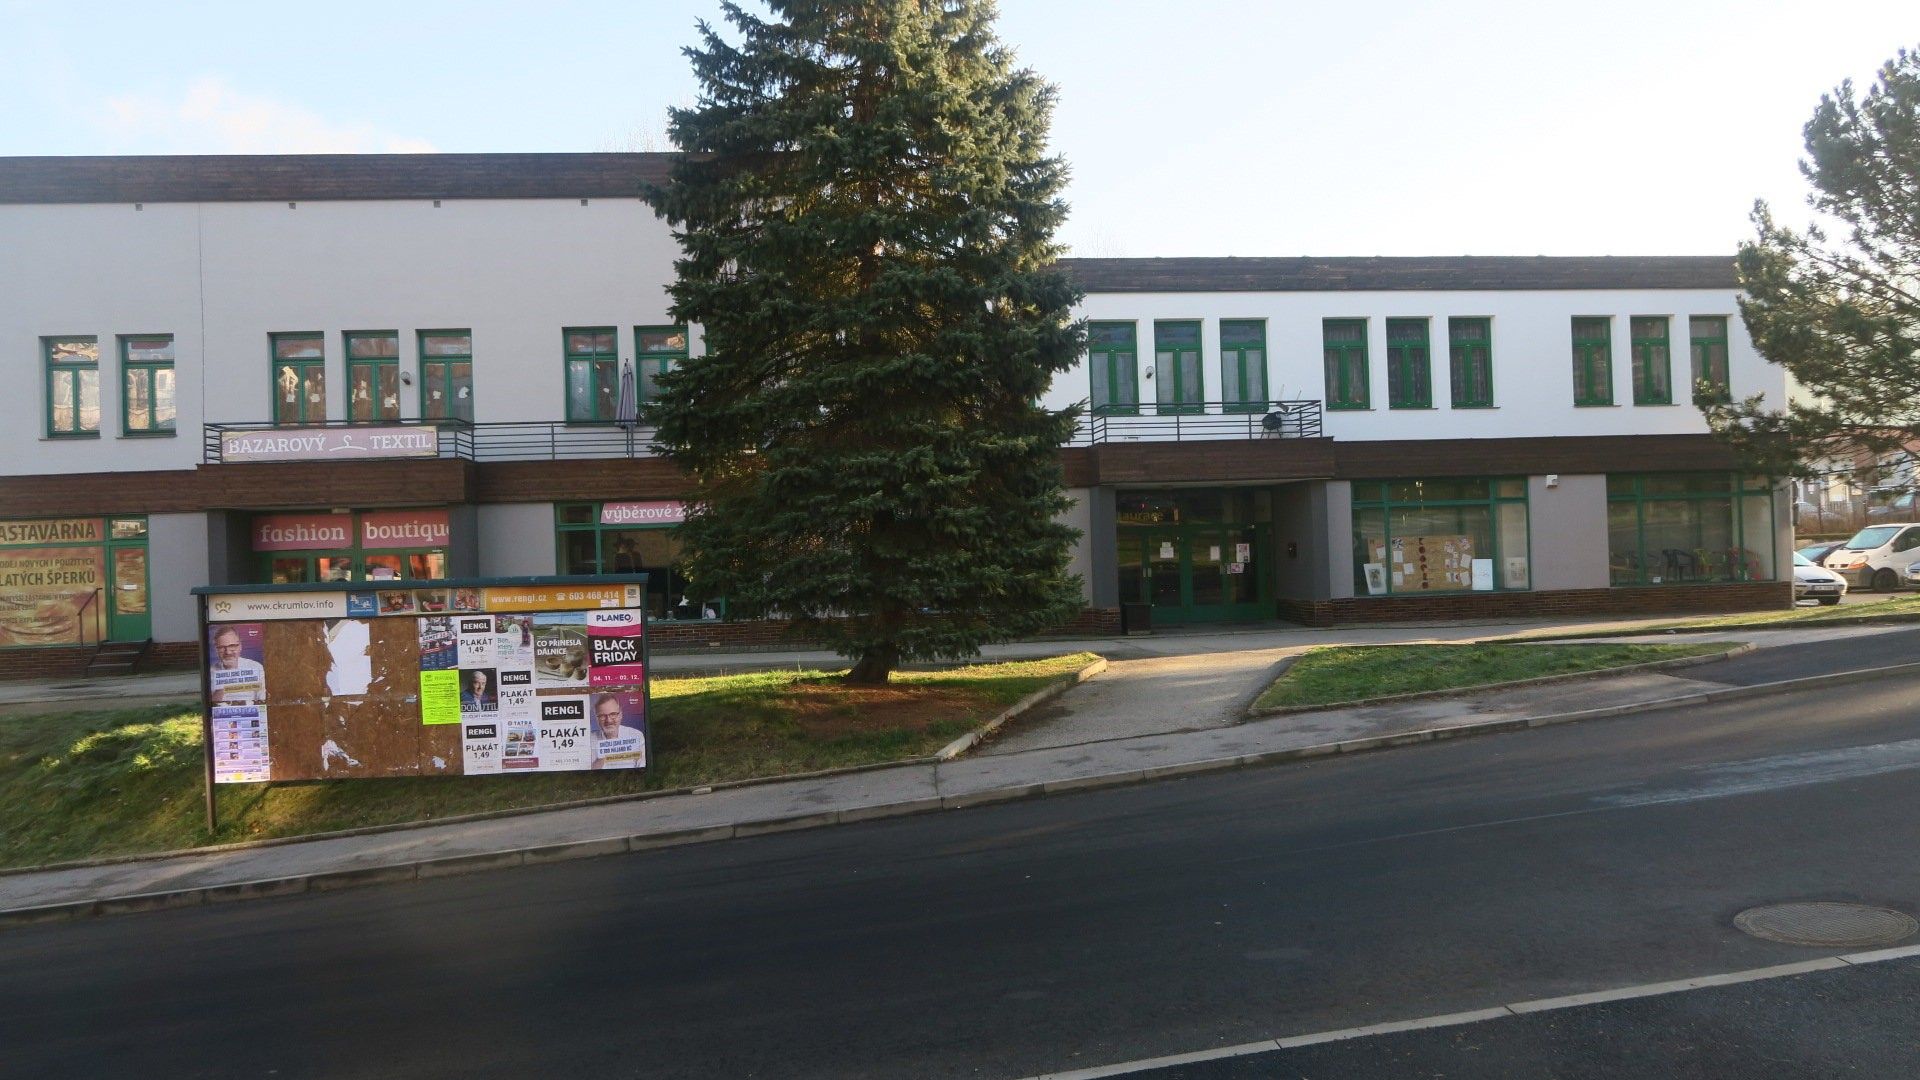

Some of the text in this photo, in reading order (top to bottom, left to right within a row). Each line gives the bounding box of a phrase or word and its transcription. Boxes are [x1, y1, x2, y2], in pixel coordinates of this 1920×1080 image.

[228, 433, 431, 454] BAZAROVÝ TEXTIL
[604, 504, 672, 522] výběrové
[261, 524, 345, 542] fashion
[491, 593, 547, 604] www.rengl.cz
[247, 600, 334, 611] www.ckrumlov.info
[596, 613, 634, 622] PLANEO
[462, 622, 489, 630] RENGL
[460, 637, 493, 646] PLAKÁT
[549, 638, 582, 647] PŘINESLA
[594, 639, 635, 651] BLACK
[468, 646, 484, 654] 1,49
[537, 646, 567, 656] DÁLNICE
[594, 651, 638, 664] FRIDAY
[502, 674, 529, 682] RENGL
[500, 689, 534, 698] PLAKÁT
[508, 697, 525, 706] 1,49
[544, 705, 581, 716] RENGL
[468, 728, 494, 736] RENGL
[541, 726, 587, 738] PLAKÁT
[466, 743, 499, 752] PLAKÁT
[552, 739, 574, 750] 1,49
[473, 752, 490, 760] 1,49
